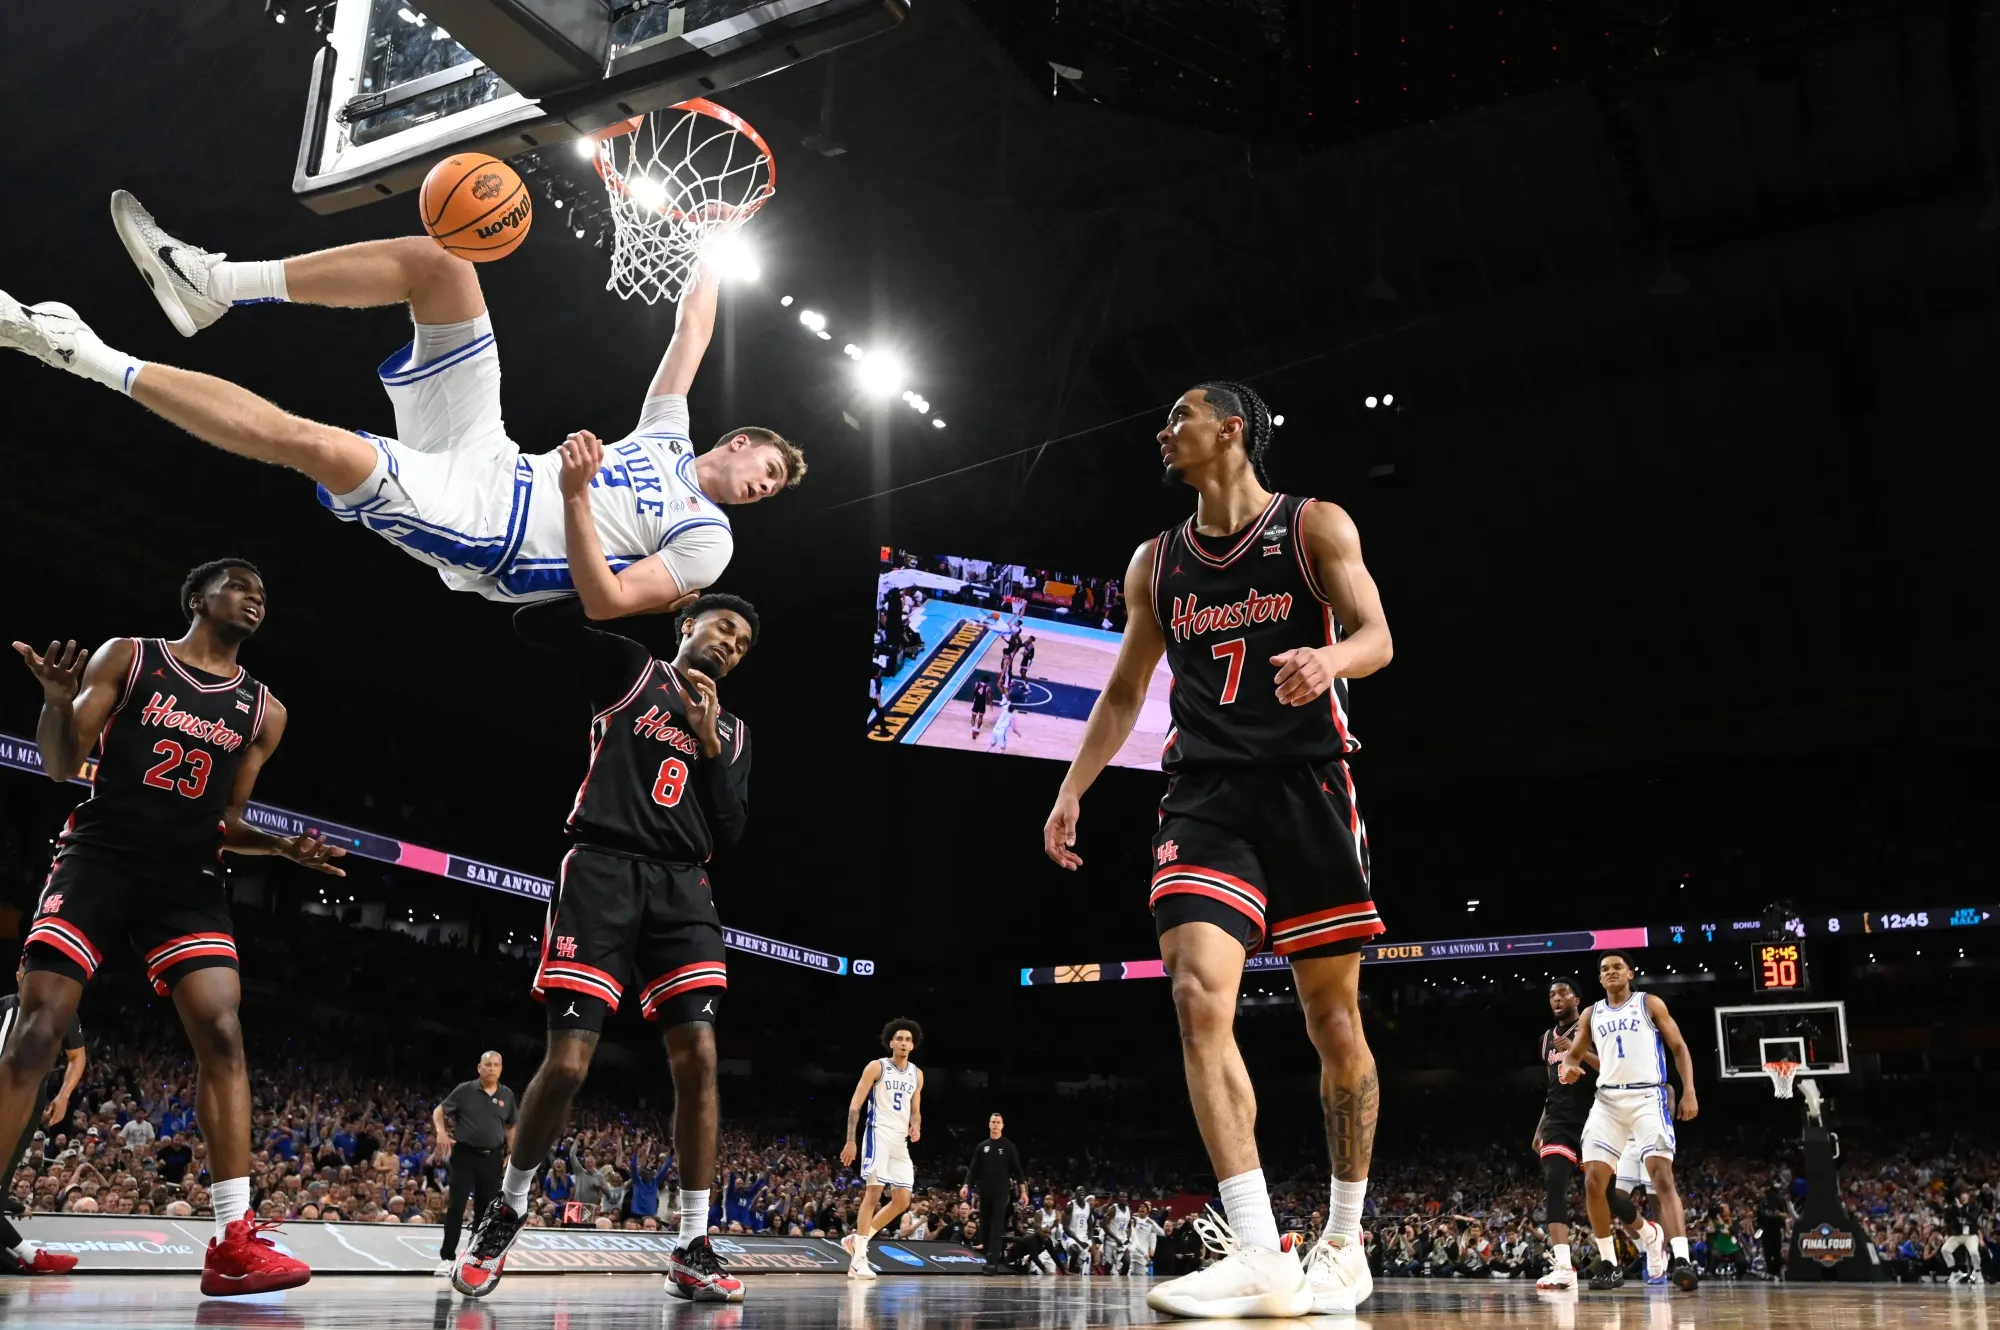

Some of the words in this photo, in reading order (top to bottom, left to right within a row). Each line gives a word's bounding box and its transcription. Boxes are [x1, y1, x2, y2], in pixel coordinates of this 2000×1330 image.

[475, 194, 531, 239] Wilson
[614, 441, 664, 517] DUKE
[1171, 588, 1293, 643] Houston
[921, 639, 967, 679] FINAL
[1211, 637, 1247, 705] 7
[141, 691, 243, 753] Houston
[633, 704, 701, 760] Hous
[0, 742, 13, 760] AA
[16, 746, 43, 766] MEN
[142, 739, 213, 799] 23
[651, 756, 689, 808] 8
[291, 820, 305, 835] TX
[466, 864, 498, 884] SAN
[500, 872, 554, 899] ANTON
[1669, 925, 1685, 934] TOL
[1701, 923, 1717, 932] FLS
[1733, 920, 1760, 930] BONUS
[1827, 917, 1840, 932] 8
[1880, 911, 1929, 930] 12:45
[1672, 934, 1682, 943] 4
[1705, 932, 1713, 943] 1
[735, 934, 768, 953] MEN'S
[770, 943, 801, 961] FINAL
[803, 952, 829, 969] FOUR
[1376, 945, 1425, 960] FOUR
[1430, 944, 1447, 956] SAN
[1488, 941, 1500, 953] TX
[1762, 945, 1798, 961] 12:45
[855, 962, 873, 974] CC
[1763, 960, 1797, 987] 30
[1597, 1018, 1641, 1038] DUKE
[1615, 1034, 1625, 1058] 1
[884, 1080, 915, 1095] DUKE
[892, 1092, 903, 1111] 5
[1802, 1238, 1827, 1249] FINAL
[1828, 1238, 1852, 1249] FOUR
